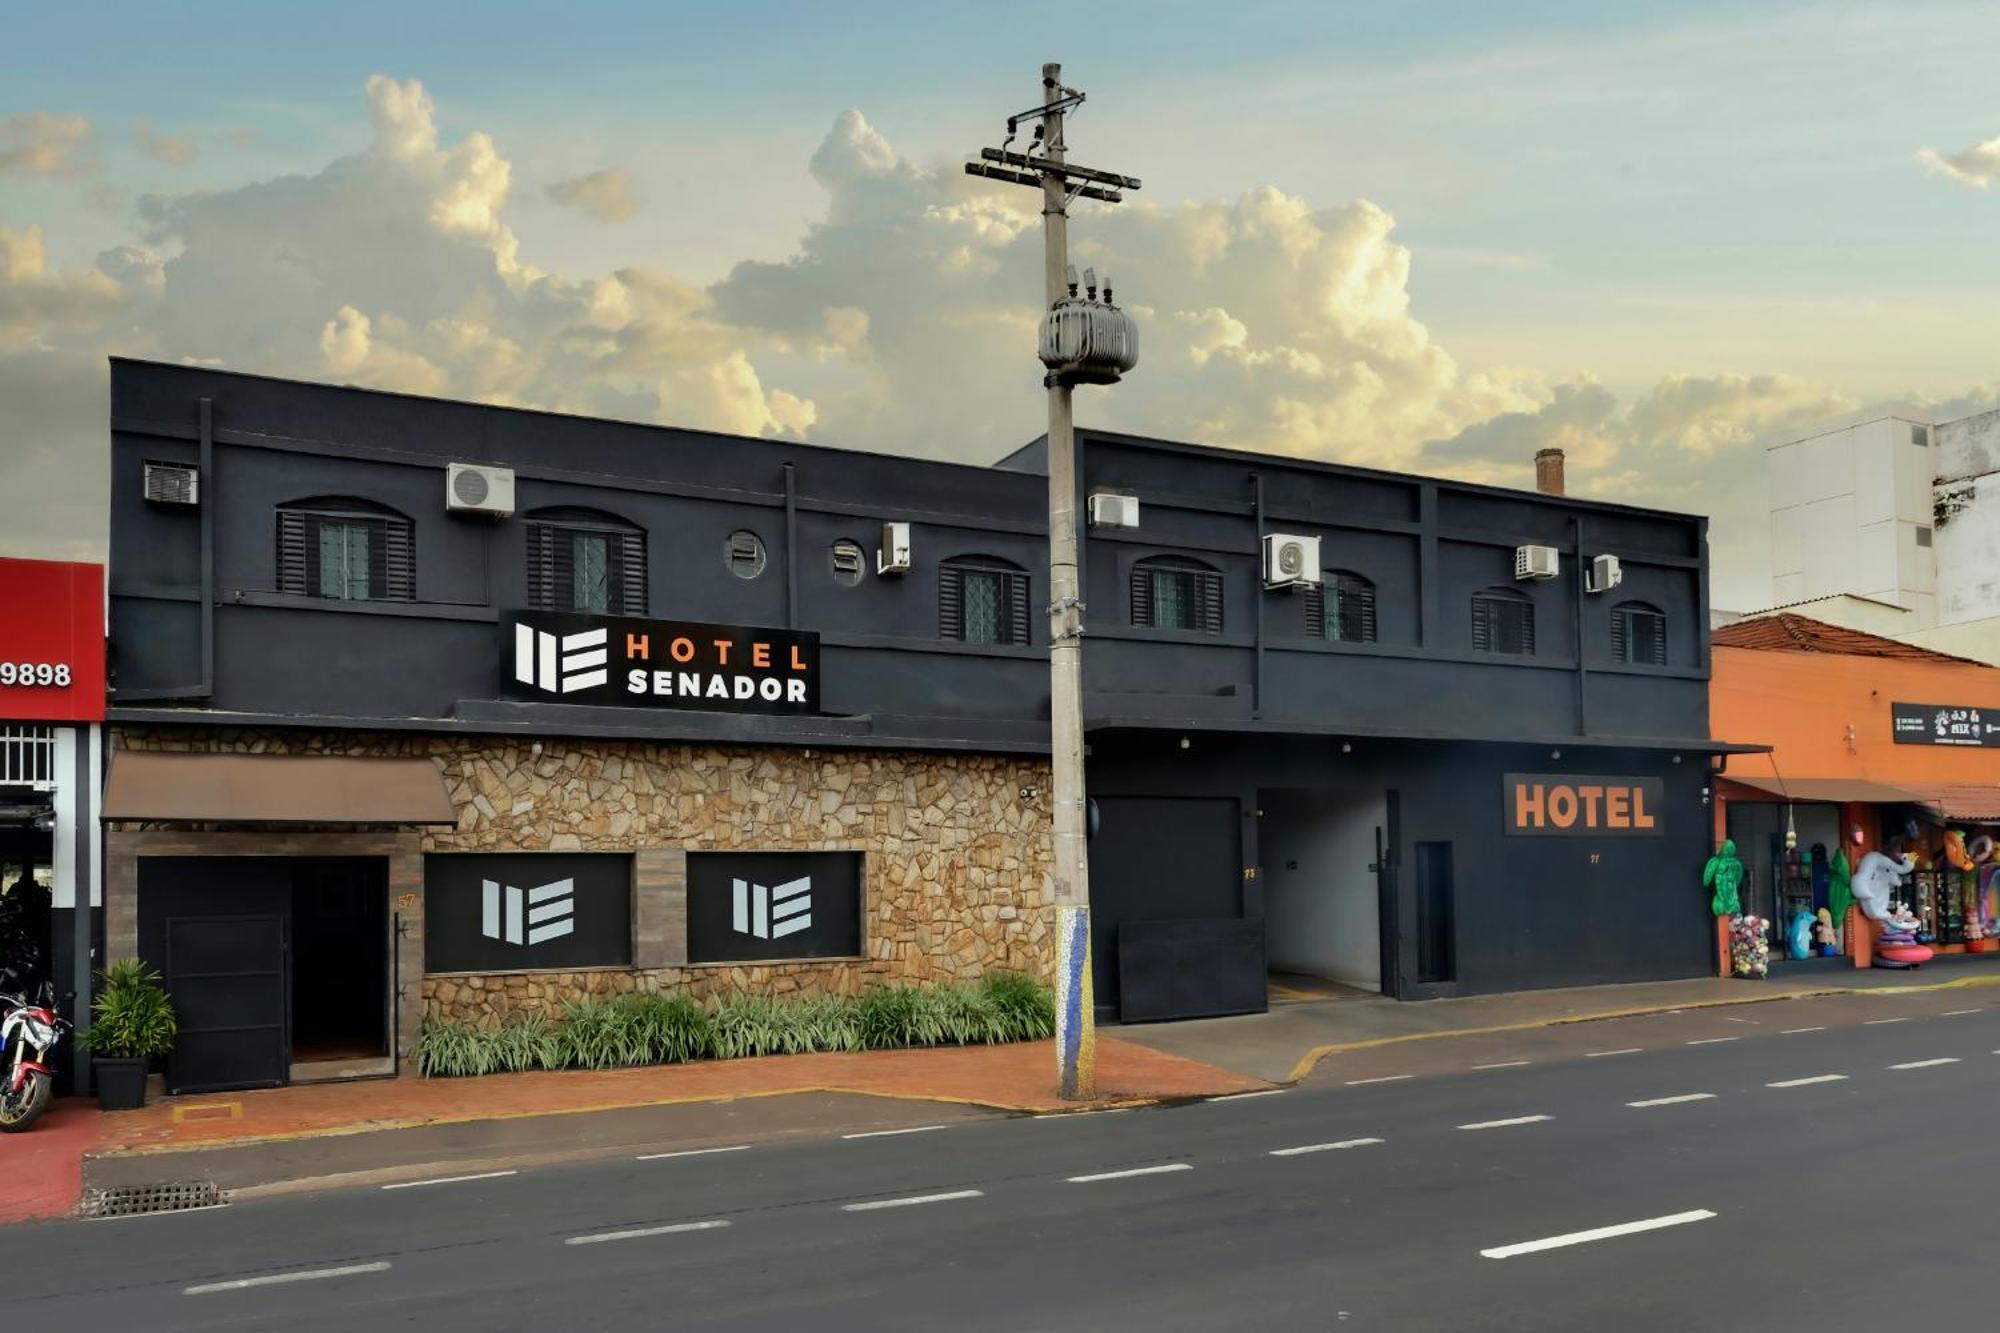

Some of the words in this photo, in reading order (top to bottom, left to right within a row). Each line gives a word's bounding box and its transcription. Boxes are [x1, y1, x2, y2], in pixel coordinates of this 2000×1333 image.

[626, 633, 807, 671] HOTEL
[0, 662, 72, 687] 9898
[626, 668, 807, 703] SENADOR
[1515, 783, 1655, 828] HOTEL
[398, 893, 417, 909] 57
